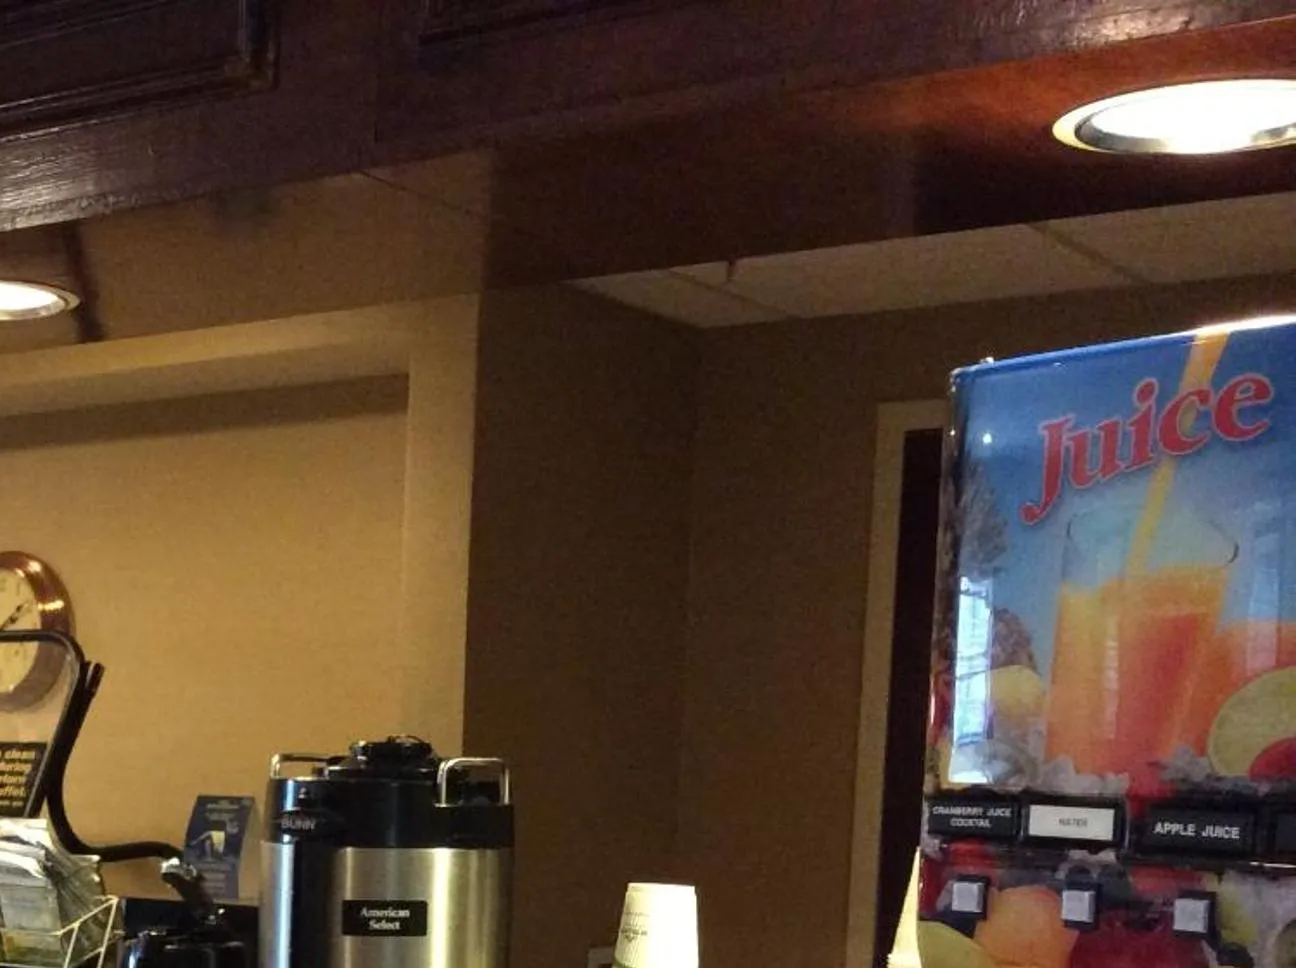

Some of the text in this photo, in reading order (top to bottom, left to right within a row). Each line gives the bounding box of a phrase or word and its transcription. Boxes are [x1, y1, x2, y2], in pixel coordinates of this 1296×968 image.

[1021, 373, 1274, 525] Juice
[4, 749, 35, 760] clean
[932, 805, 1012, 816] CRANBERRY JUICE
[281, 818, 316, 830] BUNN
[950, 817, 991, 828] COCKTAIL
[1154, 821, 1240, 839] APPLE JUICE
[359, 906, 411, 918] American
[369, 919, 401, 931] Select
